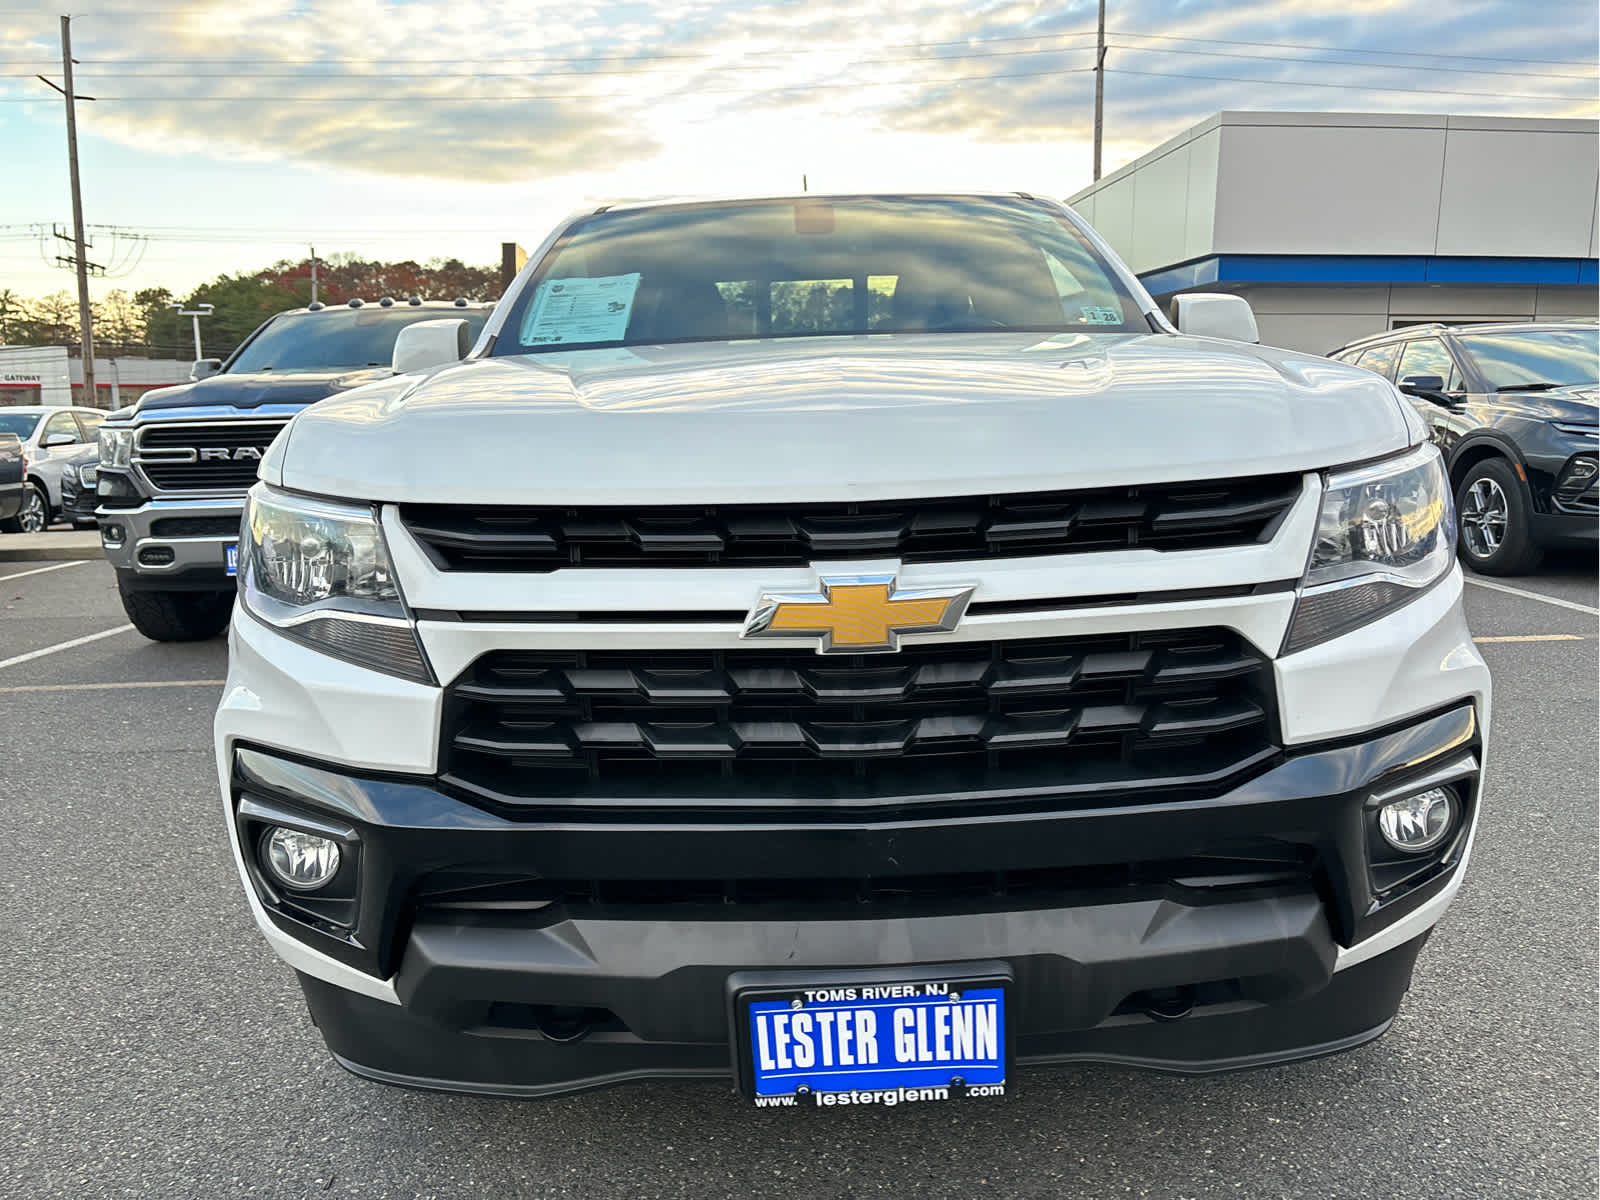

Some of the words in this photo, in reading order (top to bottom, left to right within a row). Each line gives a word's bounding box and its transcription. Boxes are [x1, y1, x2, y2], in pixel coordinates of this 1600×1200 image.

[1103, 312, 1117, 322] 28
[4, 374, 41, 382] GATEWAY
[200, 446, 269, 461] RA
[805, 989, 857, 1003] TOMS
[862, 985, 920, 1000] RIVER,
[925, 983, 948, 996] NJ
[756, 1010, 878, 1070] LESTER
[893, 1004, 997, 1062] GLENN
[816, 1087, 949, 1107] lesterglenn
